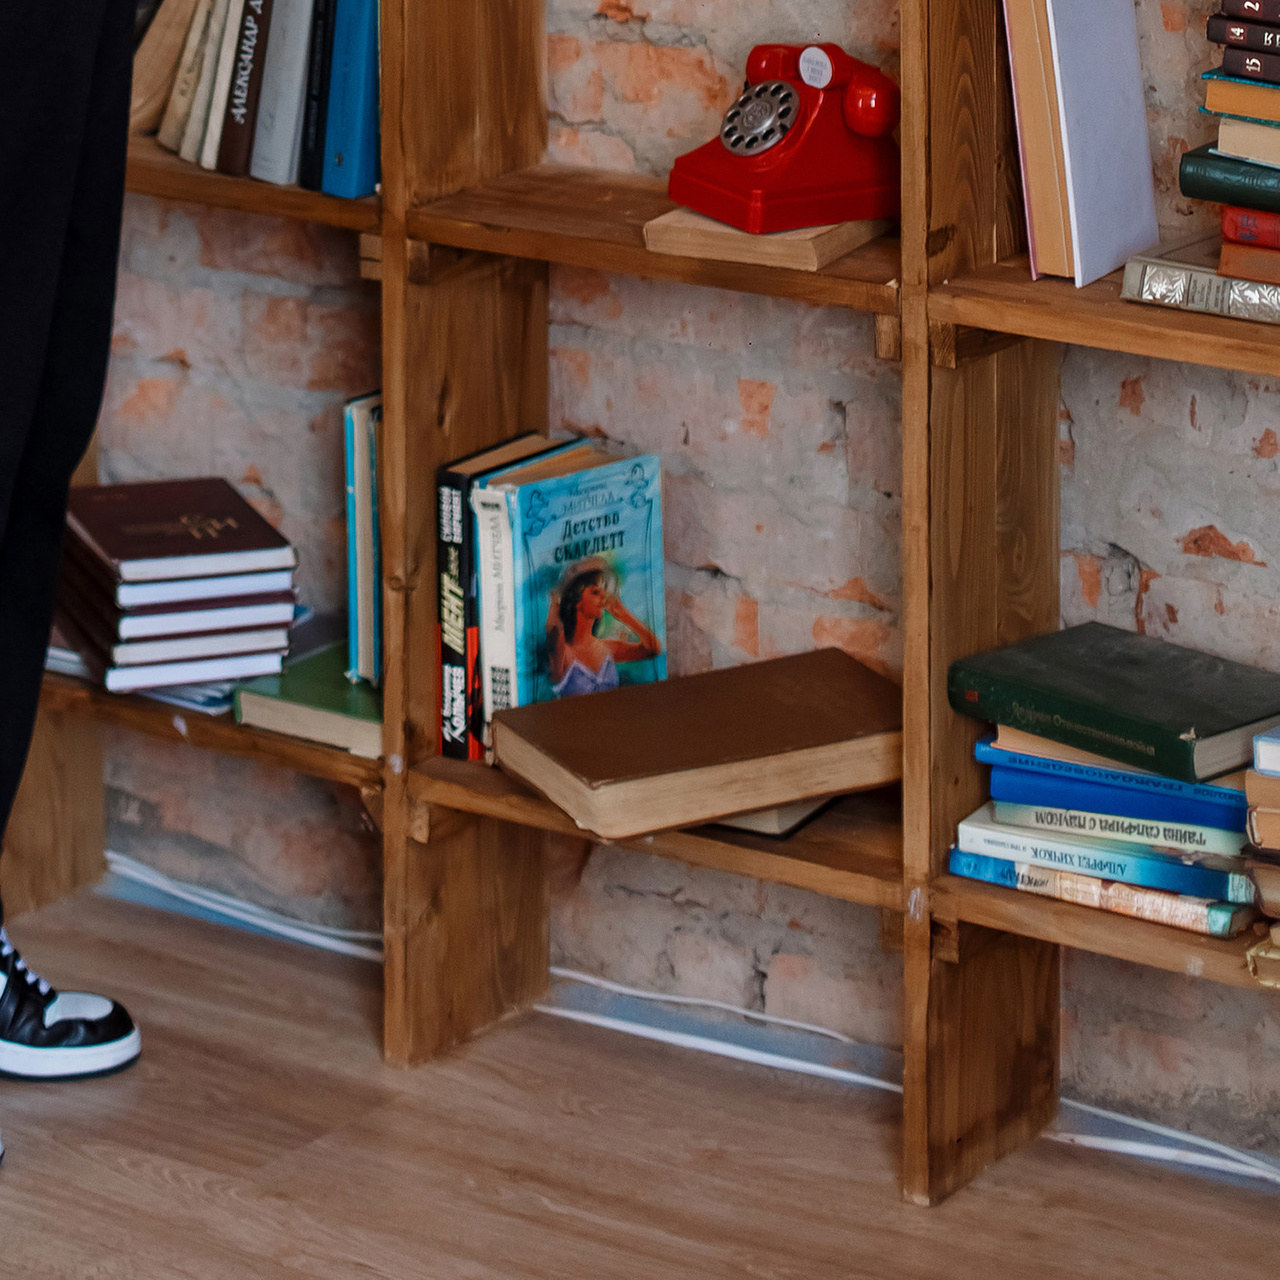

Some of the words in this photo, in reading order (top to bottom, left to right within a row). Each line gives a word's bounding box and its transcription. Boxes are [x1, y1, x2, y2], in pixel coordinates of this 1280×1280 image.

[1244, 0, 1260, 12] 2
[1230, 26, 1245, 41] 14
[231, 15, 259, 125] АЛЕКСАНДР
[1246, 57, 1261, 72] 15
[554, 530, 625, 563] СКАРЛЕТТ
[441, 572, 465, 656] МЕНТ
[1031, 846, 1076, 867] ХИЧКОК
[1078, 856, 1127, 878] АЛЬФРЕД
